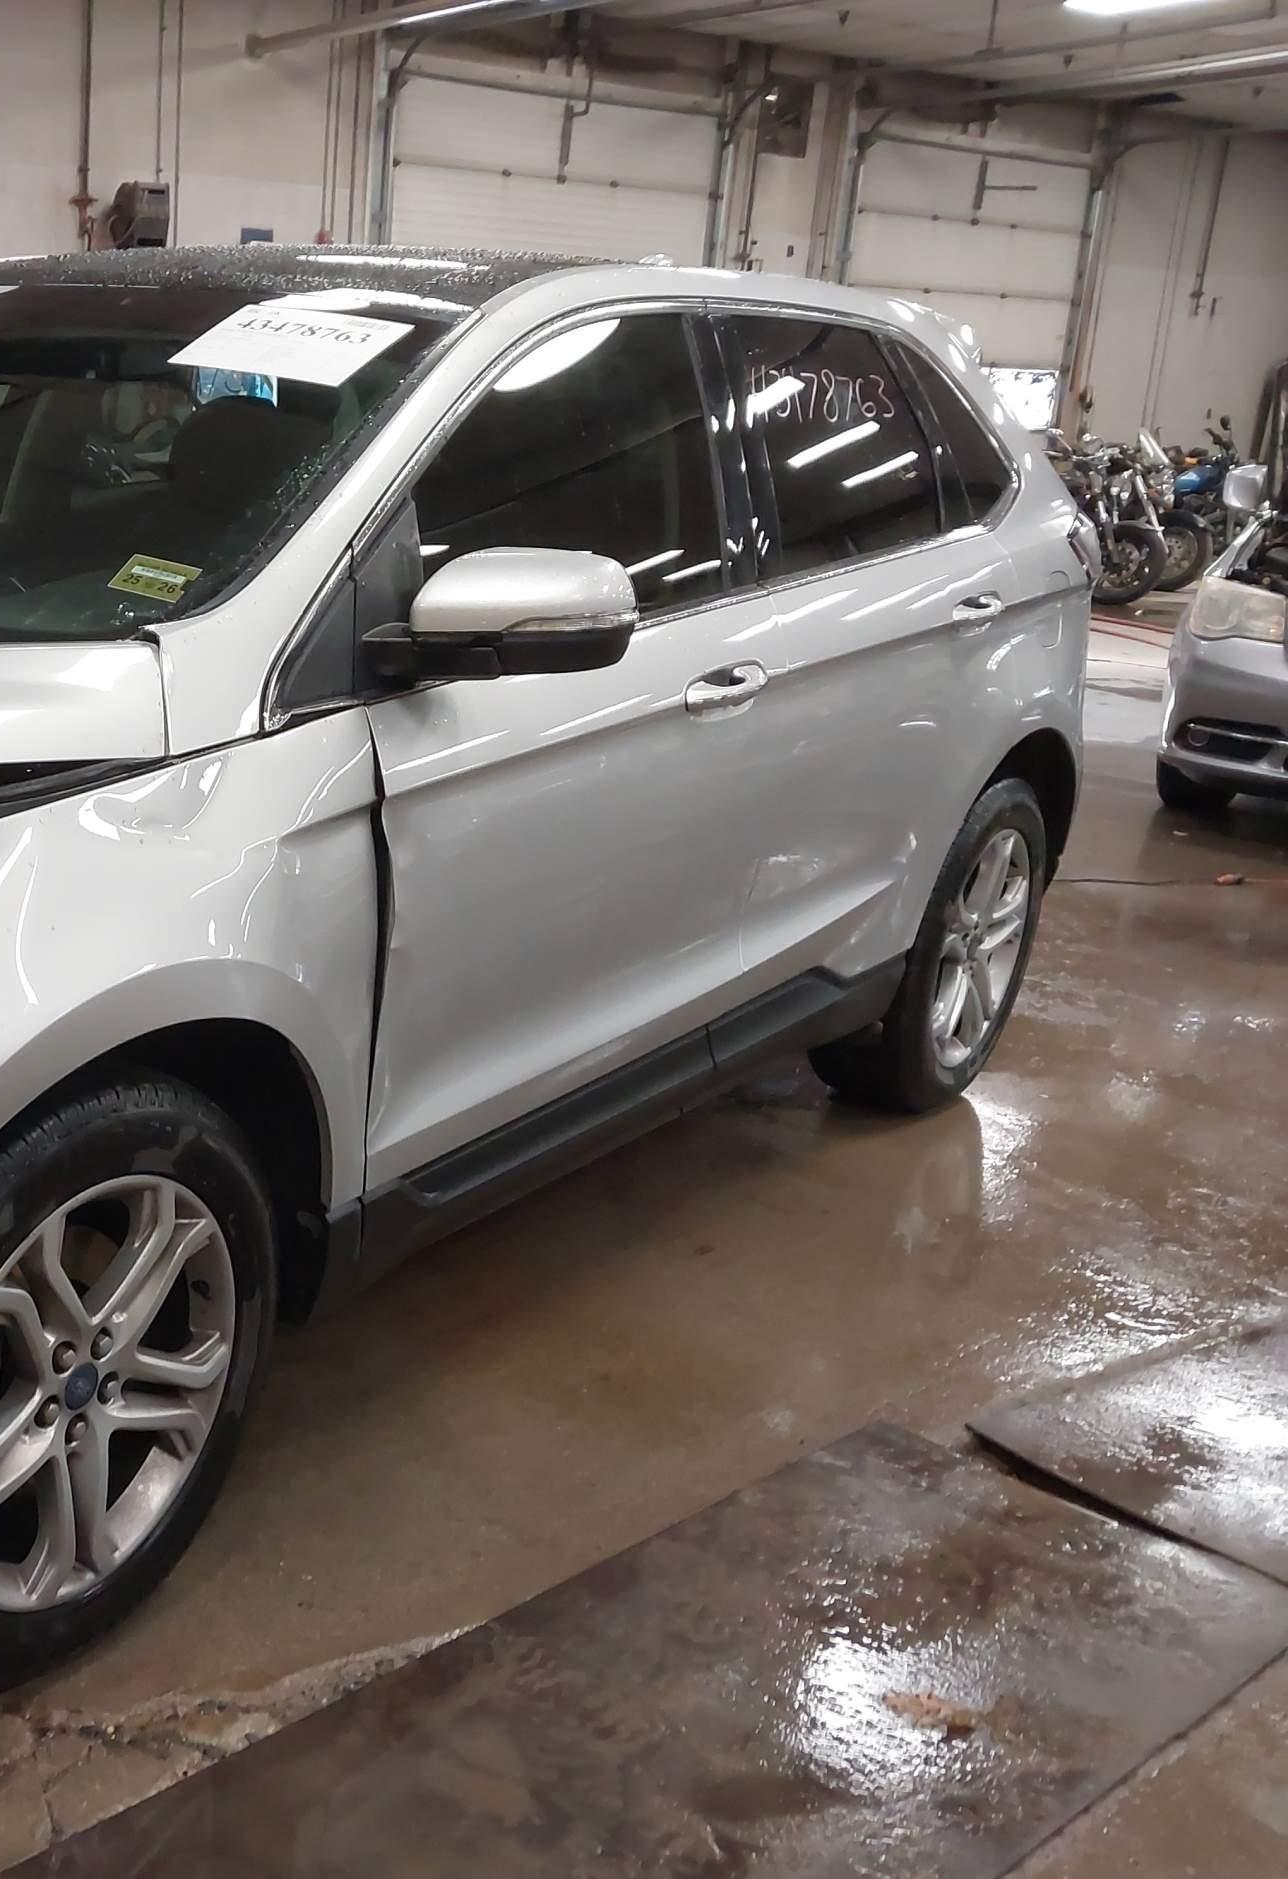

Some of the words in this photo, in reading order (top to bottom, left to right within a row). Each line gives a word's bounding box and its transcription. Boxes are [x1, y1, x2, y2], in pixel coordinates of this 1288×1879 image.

[237, 318, 371, 345] 43478763
[122, 574, 143, 585] 25
[158, 582, 178, 594] 26
